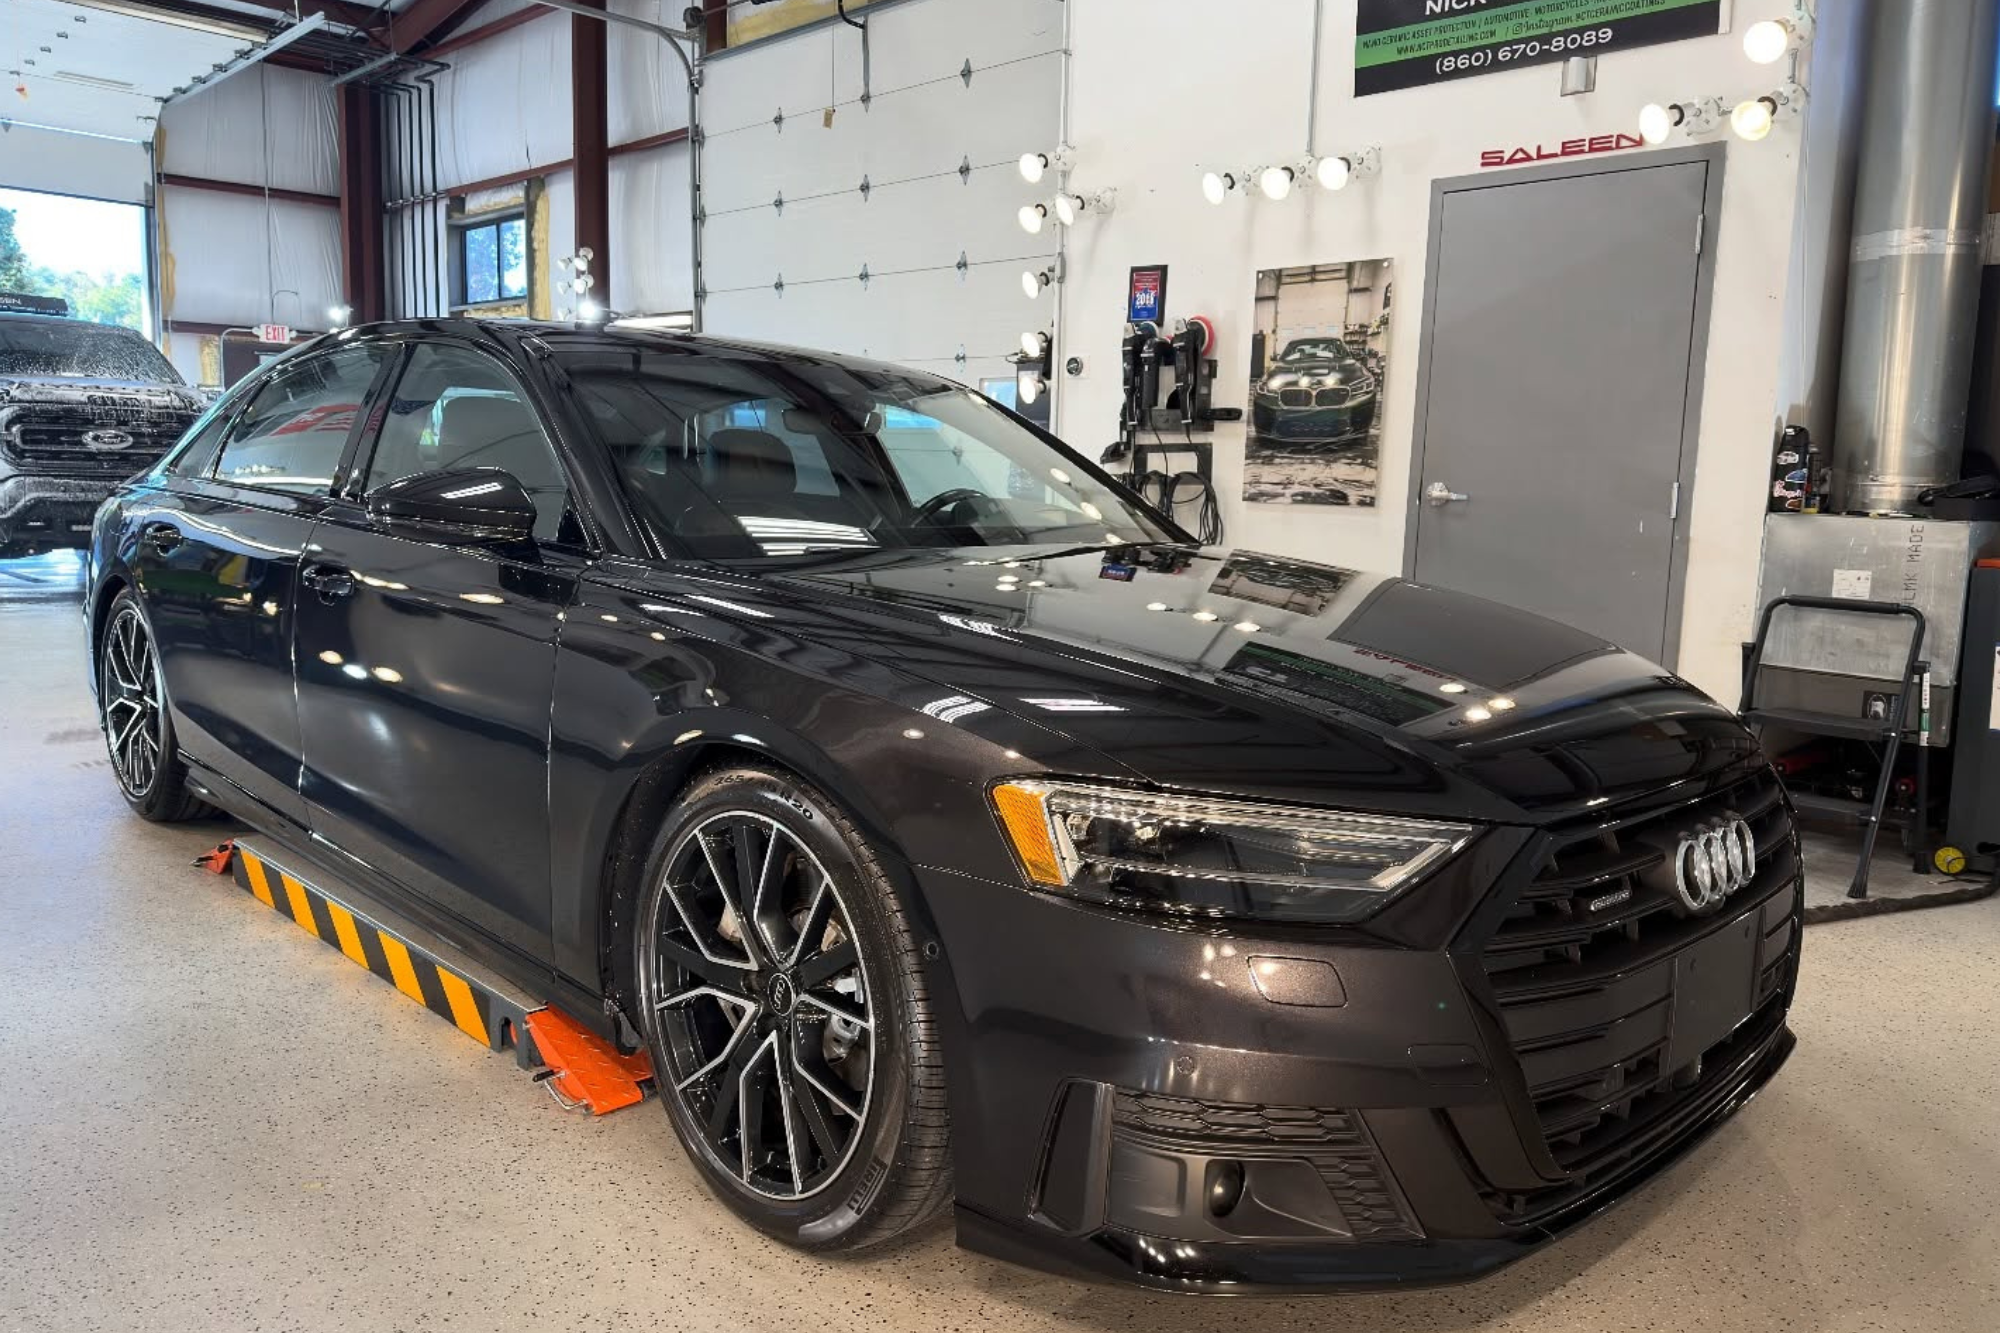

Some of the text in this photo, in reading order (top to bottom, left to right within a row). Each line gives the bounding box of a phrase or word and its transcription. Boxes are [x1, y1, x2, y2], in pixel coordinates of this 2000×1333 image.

[1412, 28, 1432, 40] ASSET
[1433, 20, 1477, 35] PROTECTION
[1436, 28, 1613, 75] (860) 670-8089
[1481, 132, 1643, 167] SALEEN
[265, 325, 286, 342] EXIT
[1906, 524, 1925, 562] MADE
